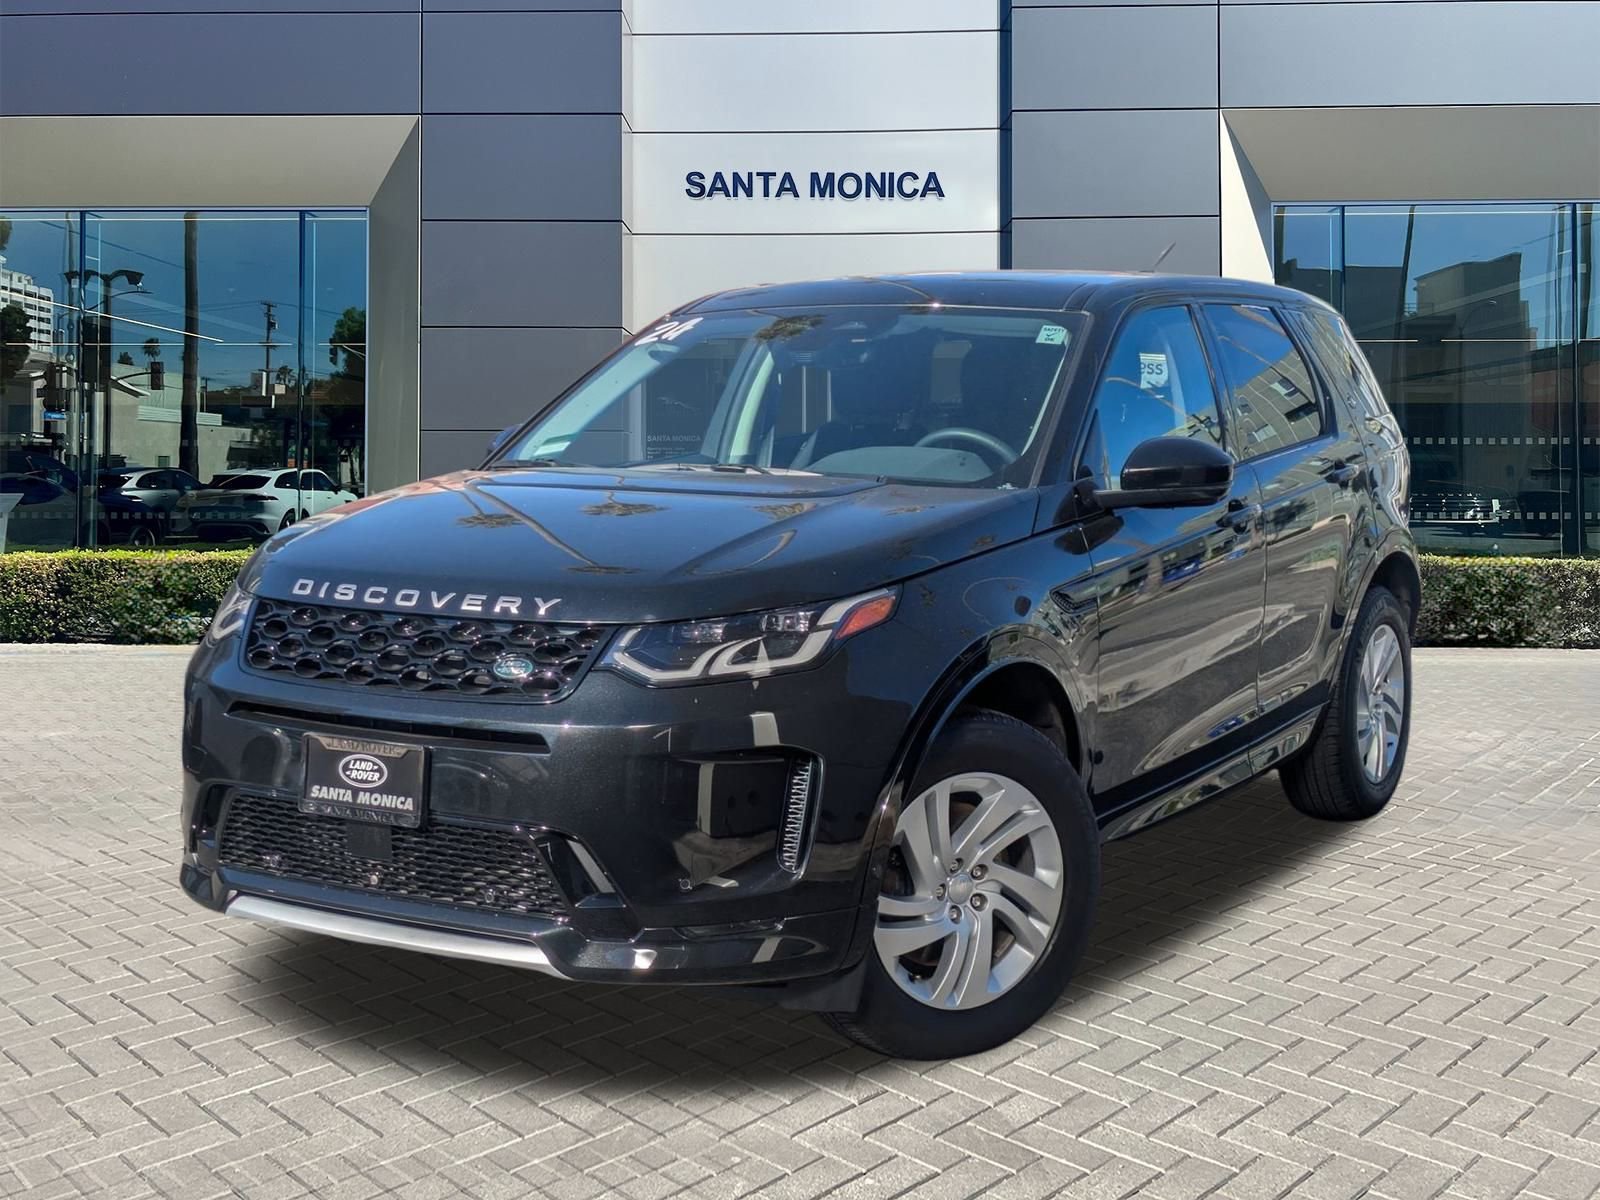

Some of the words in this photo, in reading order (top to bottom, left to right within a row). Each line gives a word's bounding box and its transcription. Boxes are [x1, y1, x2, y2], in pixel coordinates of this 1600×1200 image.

[685, 171, 800, 199] SANTA
[809, 171, 945, 199] MONICA
[647, 434, 671, 442] SANTA
[672, 434, 701, 442] MONICA
[292, 578, 562, 615] DISCOVERY
[349, 760, 373, 771] LAND
[350, 770, 380, 781] ROVER
[311, 785, 353, 802] SANTA
[357, 791, 414, 810] MONICA
